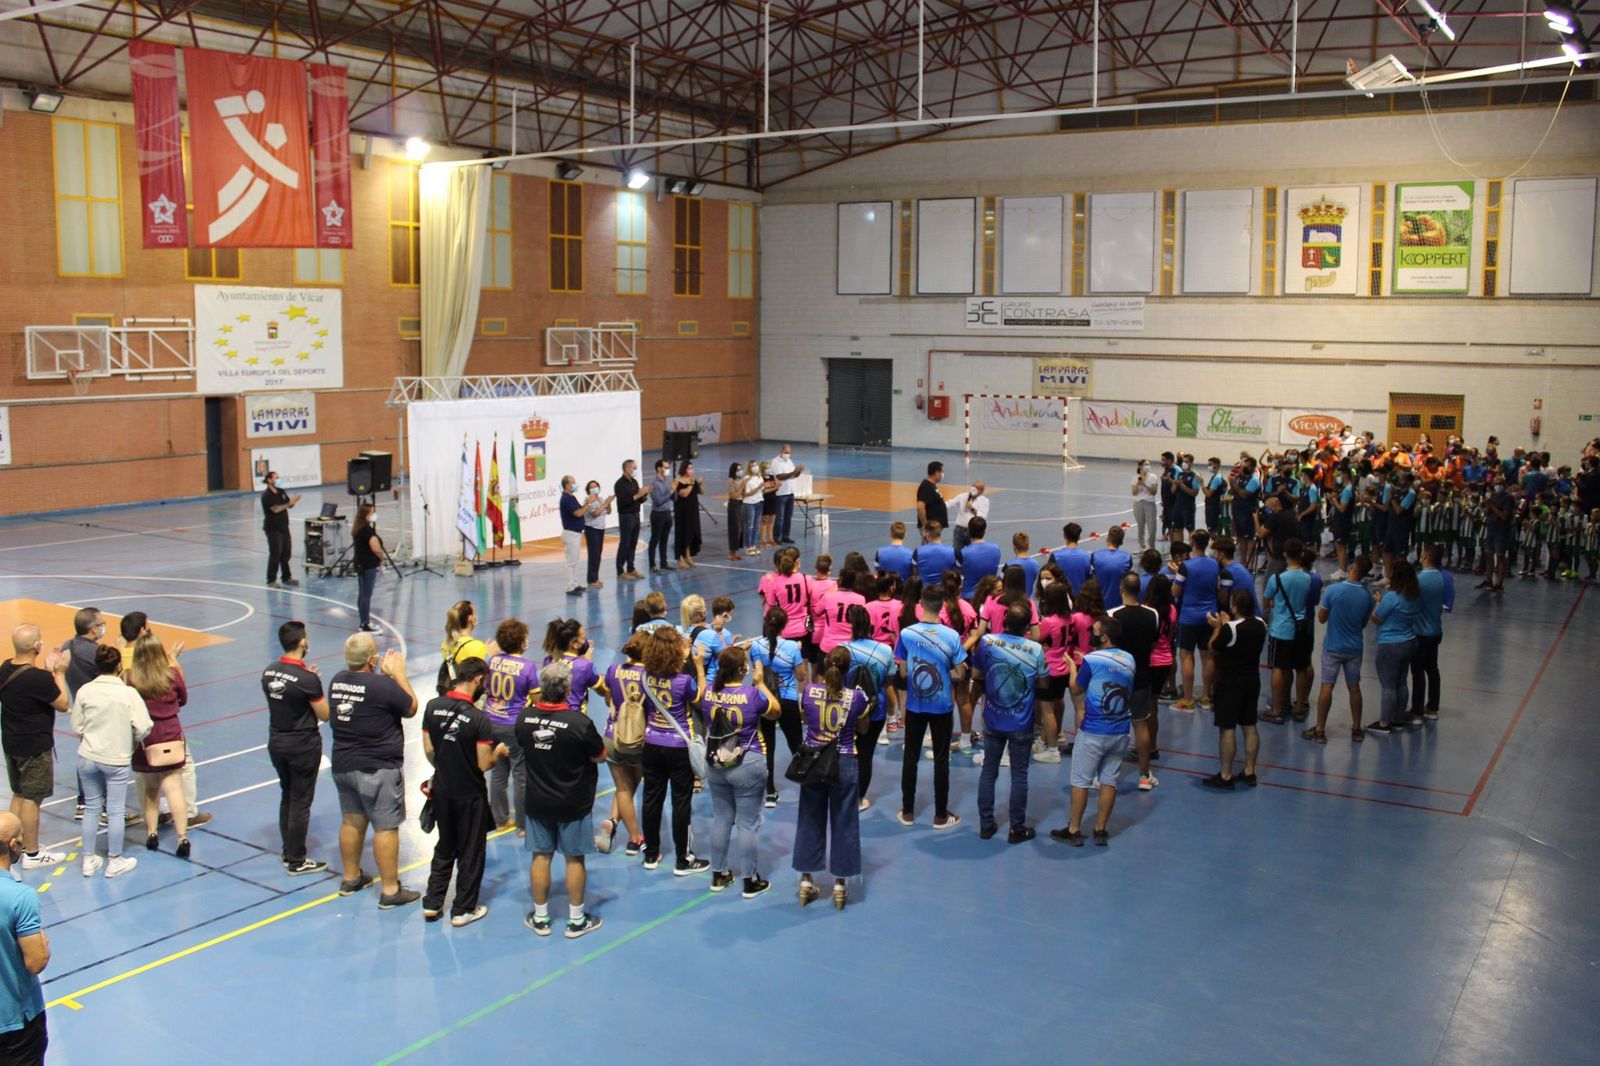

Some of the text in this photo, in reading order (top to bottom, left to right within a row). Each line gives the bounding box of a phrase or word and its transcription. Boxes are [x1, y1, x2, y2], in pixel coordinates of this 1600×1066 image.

[217, 290, 284, 303] Ayuntamiento
[285, 291, 297, 301] de
[1003, 307, 1091, 318] CONTRASA
[217, 368, 326, 377] VILLA EUROPEA DEL DEPORTE
[1040, 375, 1087, 384] MIVI
[1086, 406, 1173, 431] Andalucía
[254, 419, 307, 433] MIVI
[785, 583, 801, 604] 11
[491, 671, 515, 701] 00
[814, 700, 843, 732] 10
